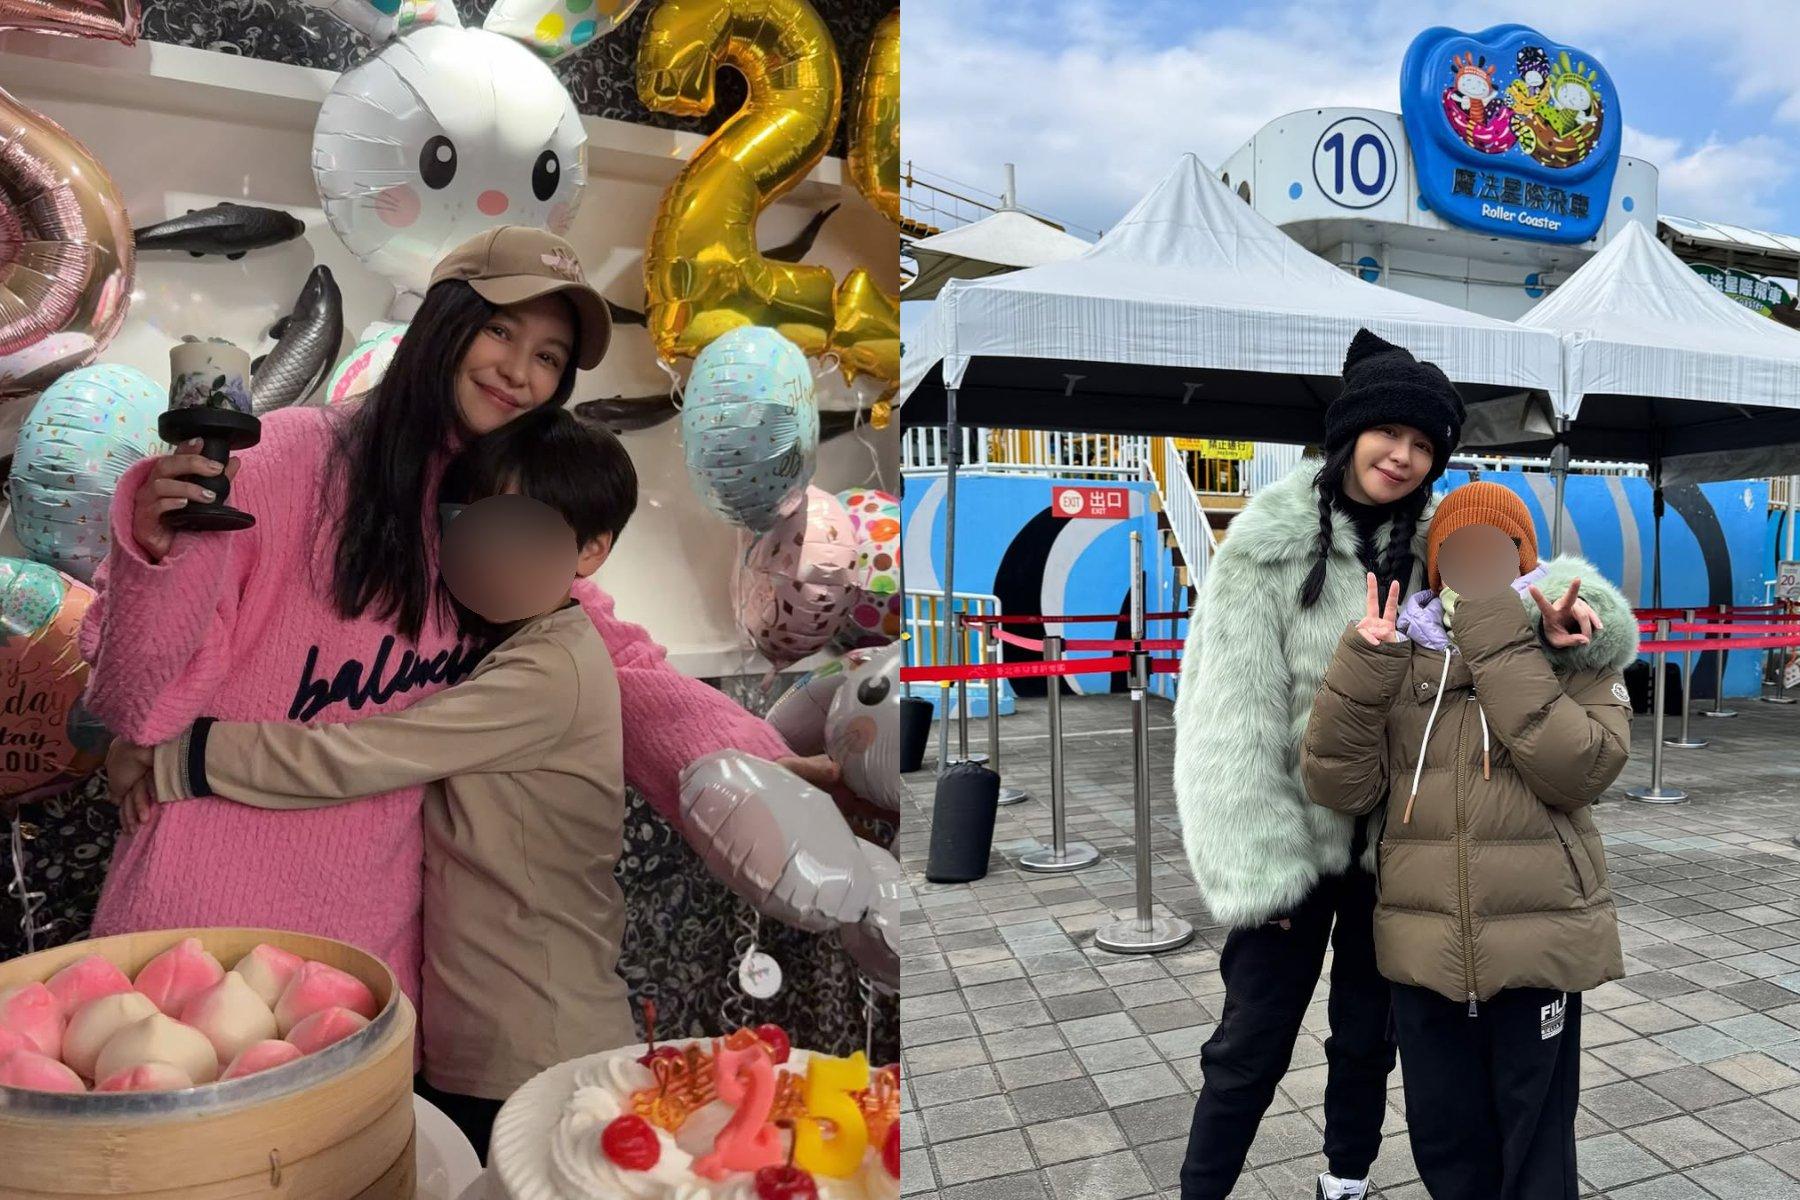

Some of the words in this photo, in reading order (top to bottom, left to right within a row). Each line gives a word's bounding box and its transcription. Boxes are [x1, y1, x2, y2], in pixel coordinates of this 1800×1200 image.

[1323, 132, 1387, 196] 10
[1452, 168, 1591, 218] 魔法星際飛車
[1481, 203, 1516, 221] Roller
[1518, 211, 1562, 231] Coaster
[1700, 273, 1782, 305] 法星際飛車
[1063, 496, 1080, 508] EXIT
[1090, 491, 1121, 508] 出口
[1781, 574, 1795, 586] 20
[0, 681, 66, 727] day
[0, 726, 61, 751] tay
[0, 750, 58, 772] OUS
